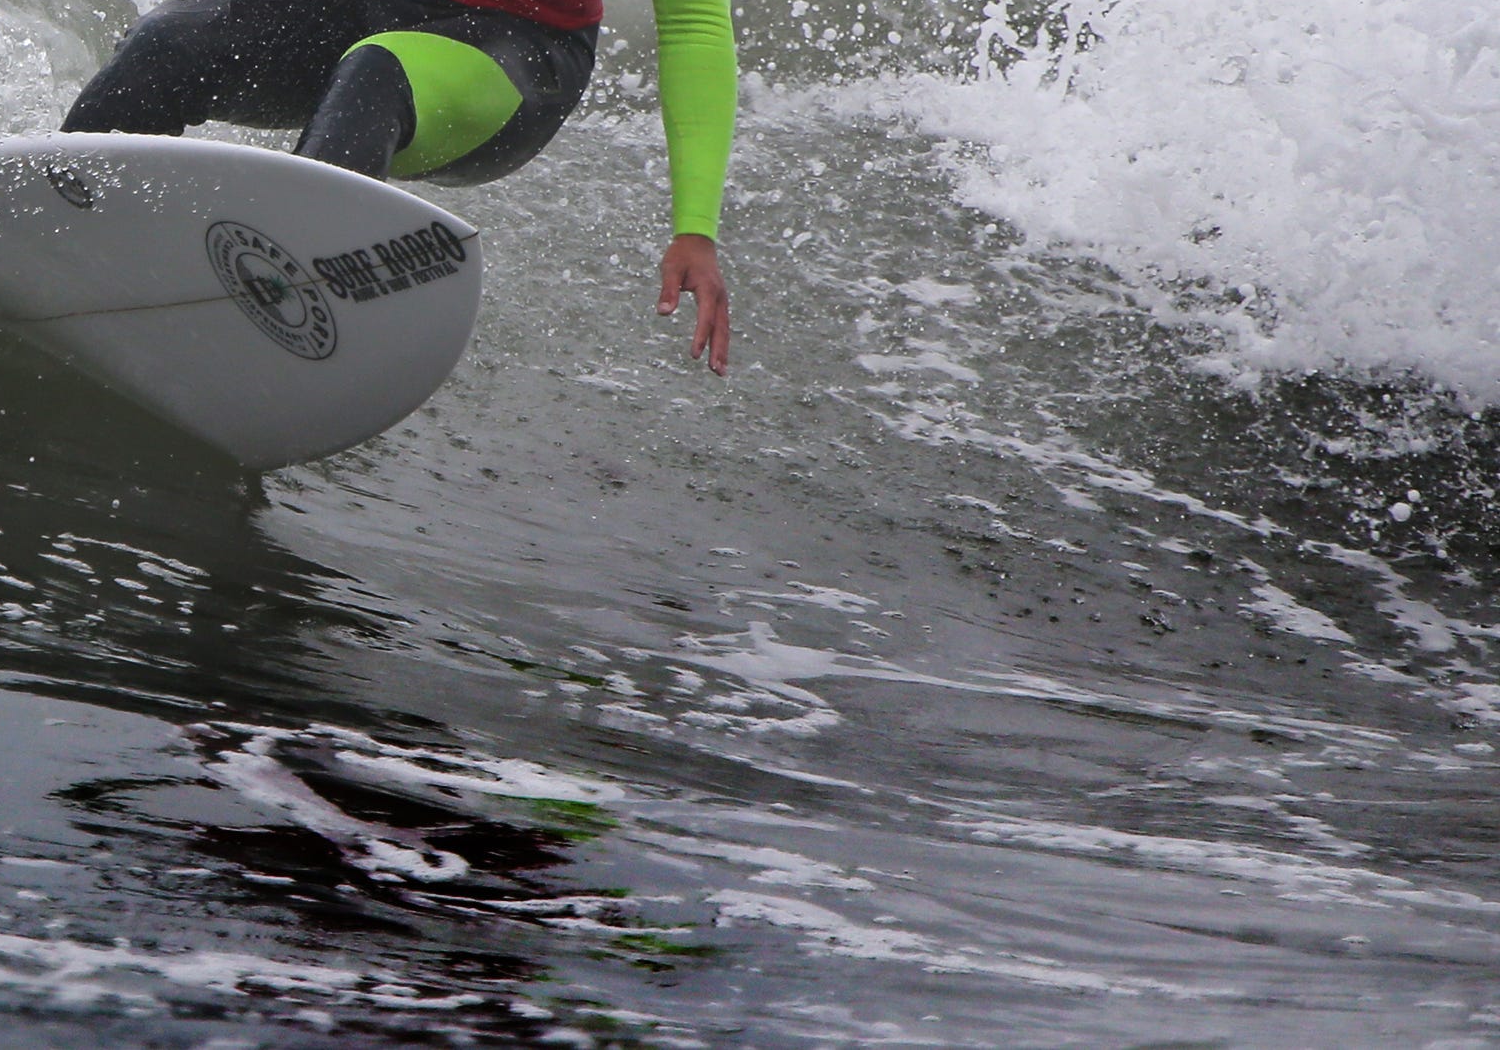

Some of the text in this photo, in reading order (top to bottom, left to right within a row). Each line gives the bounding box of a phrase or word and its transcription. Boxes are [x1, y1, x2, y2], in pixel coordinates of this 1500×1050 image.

[235, 230, 298, 277] SAFE
[303, 288, 329, 349] PORT
[313, 250, 380, 299] SURF
[372, 221, 466, 275] RODEO
[411, 261, 459, 285] FESTIVAL
